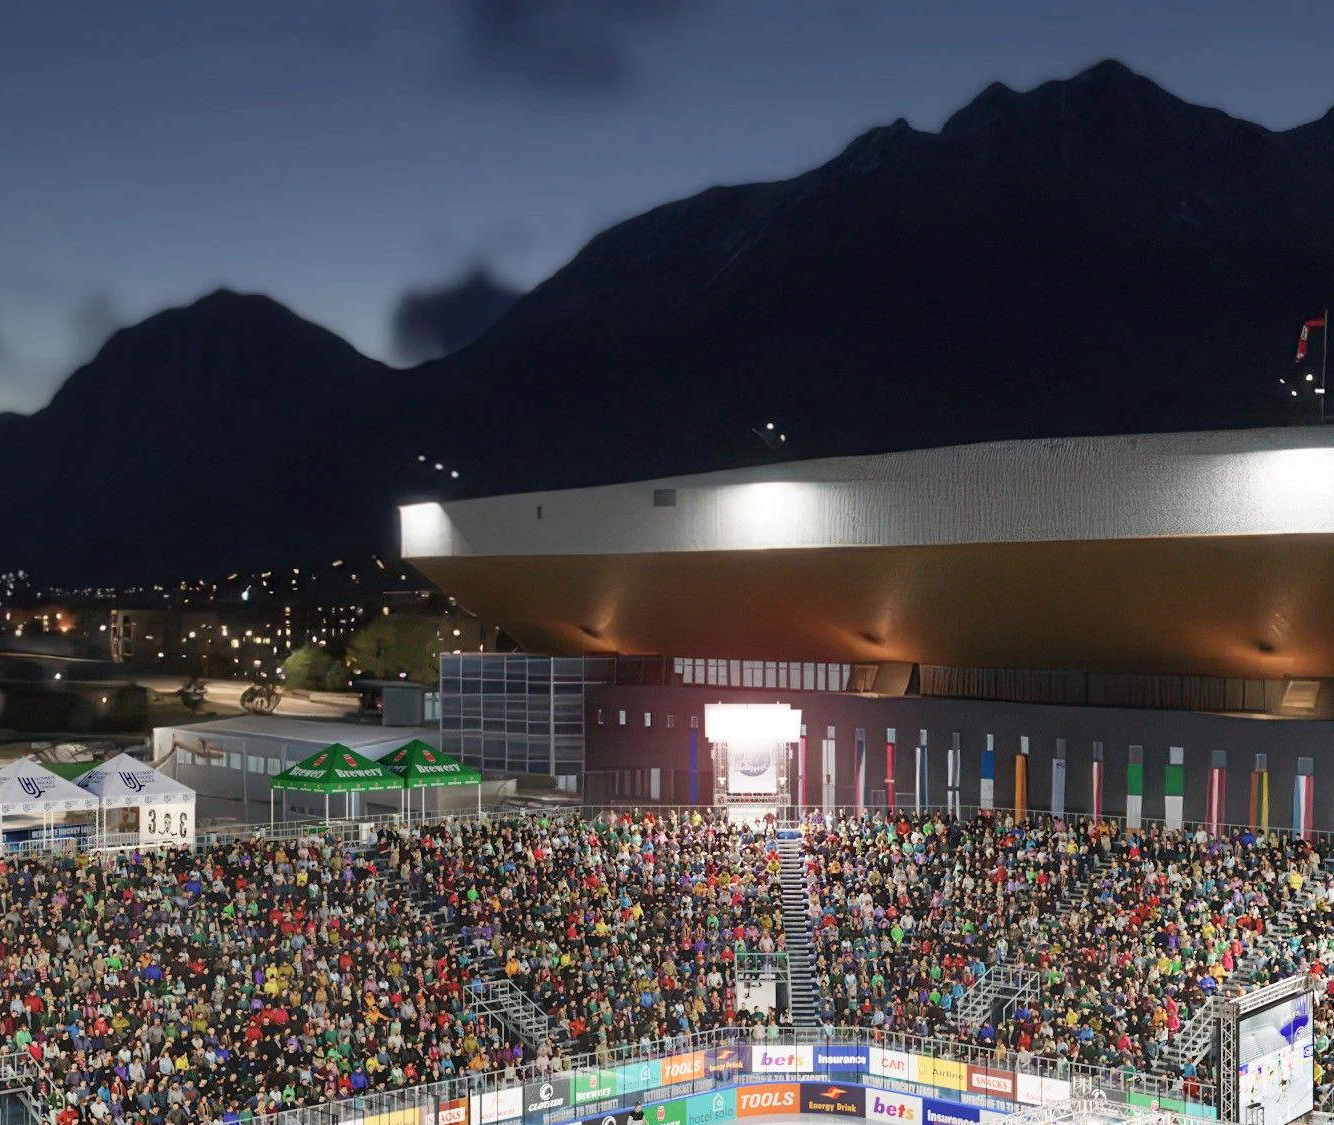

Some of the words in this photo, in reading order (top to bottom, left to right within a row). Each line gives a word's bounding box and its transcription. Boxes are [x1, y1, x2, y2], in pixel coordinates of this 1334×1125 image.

[289, 766, 327, 779] Brewery
[335, 768, 383, 778] Brewery
[415, 763, 461, 774] Brewery
[761, 1052, 805, 1066] bets
[818, 1054, 867, 1065] Insurance
[881, 1057, 906, 1071] CAR
[664, 1060, 702, 1078] TOOLS
[932, 1068, 964, 1081] Airline
[976, 1076, 1008, 1090] SNACKS
[576, 1088, 611, 1101] Brewery
[741, 1092, 795, 1108] TOOLS
[528, 1098, 563, 1112] CLOTHES
[809, 1101, 834, 1113] Energy
[836, 1102, 857, 1112] Drink
[874, 1097, 914, 1120] bets
[428, 1110, 462, 1125] SACKS
[689, 1112, 712, 1125] hotel
[713, 1108, 735, 1120] solo
